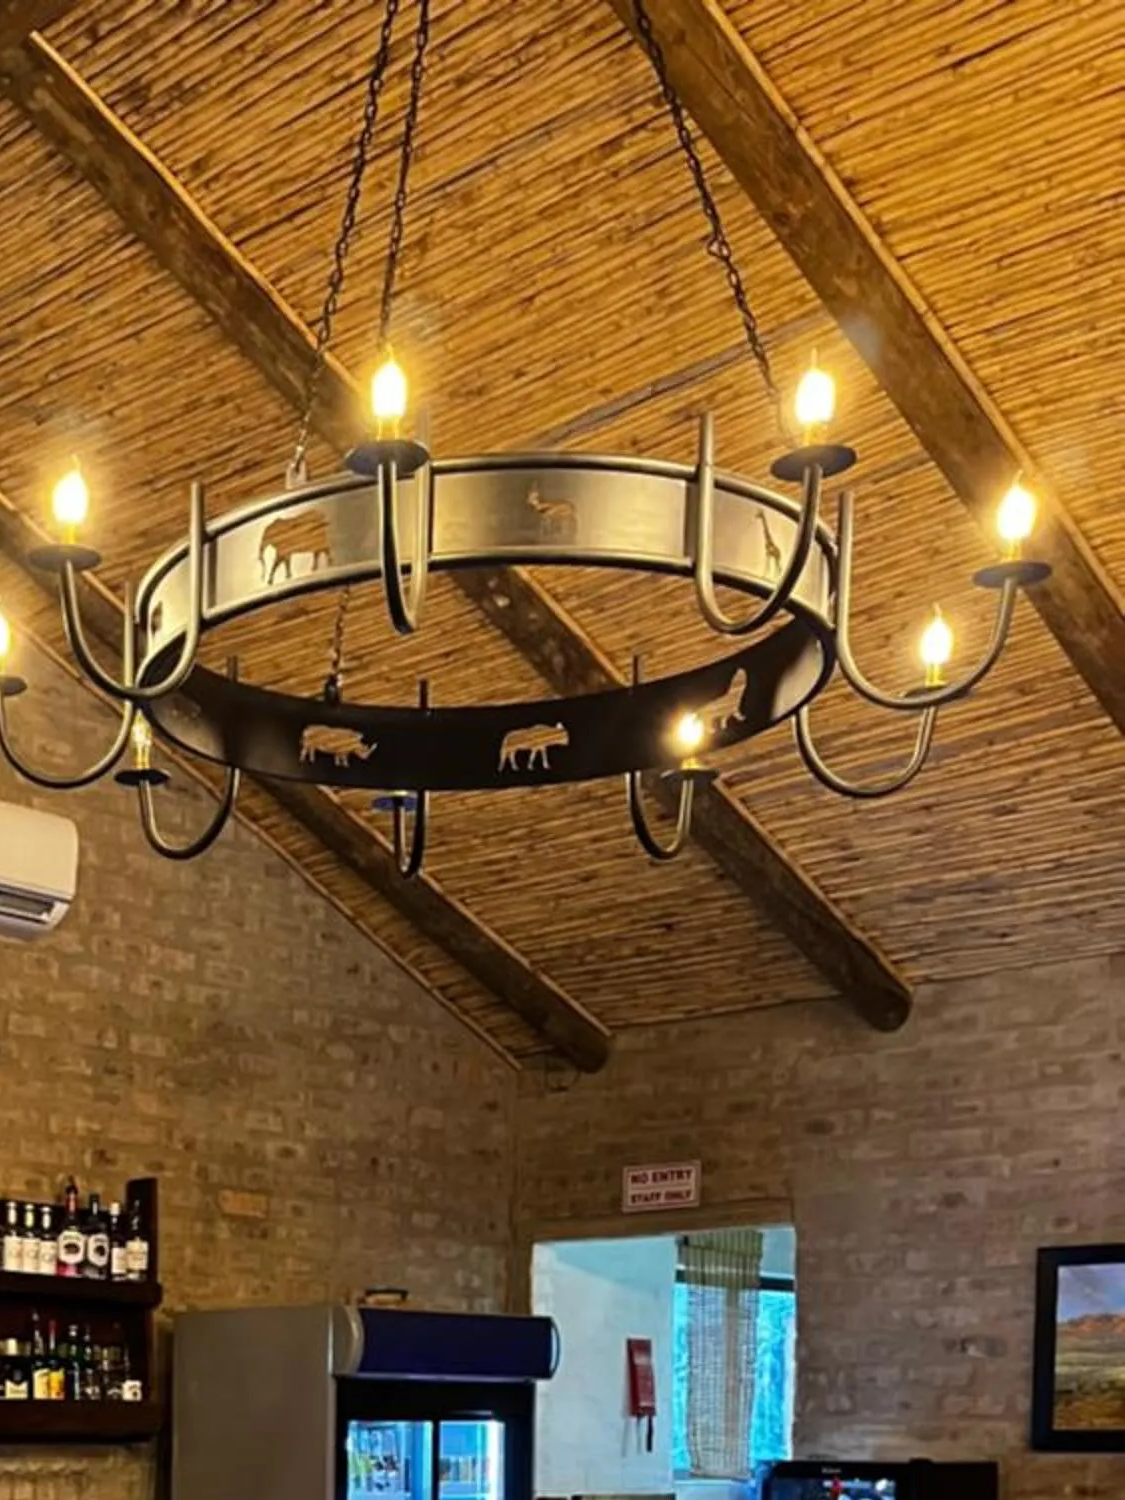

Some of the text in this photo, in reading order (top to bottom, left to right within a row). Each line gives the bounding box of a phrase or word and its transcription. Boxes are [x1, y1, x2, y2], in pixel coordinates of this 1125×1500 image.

[631, 1170, 692, 1184] NO ENTRY
[631, 1190, 692, 1204] STAFF ONLY
